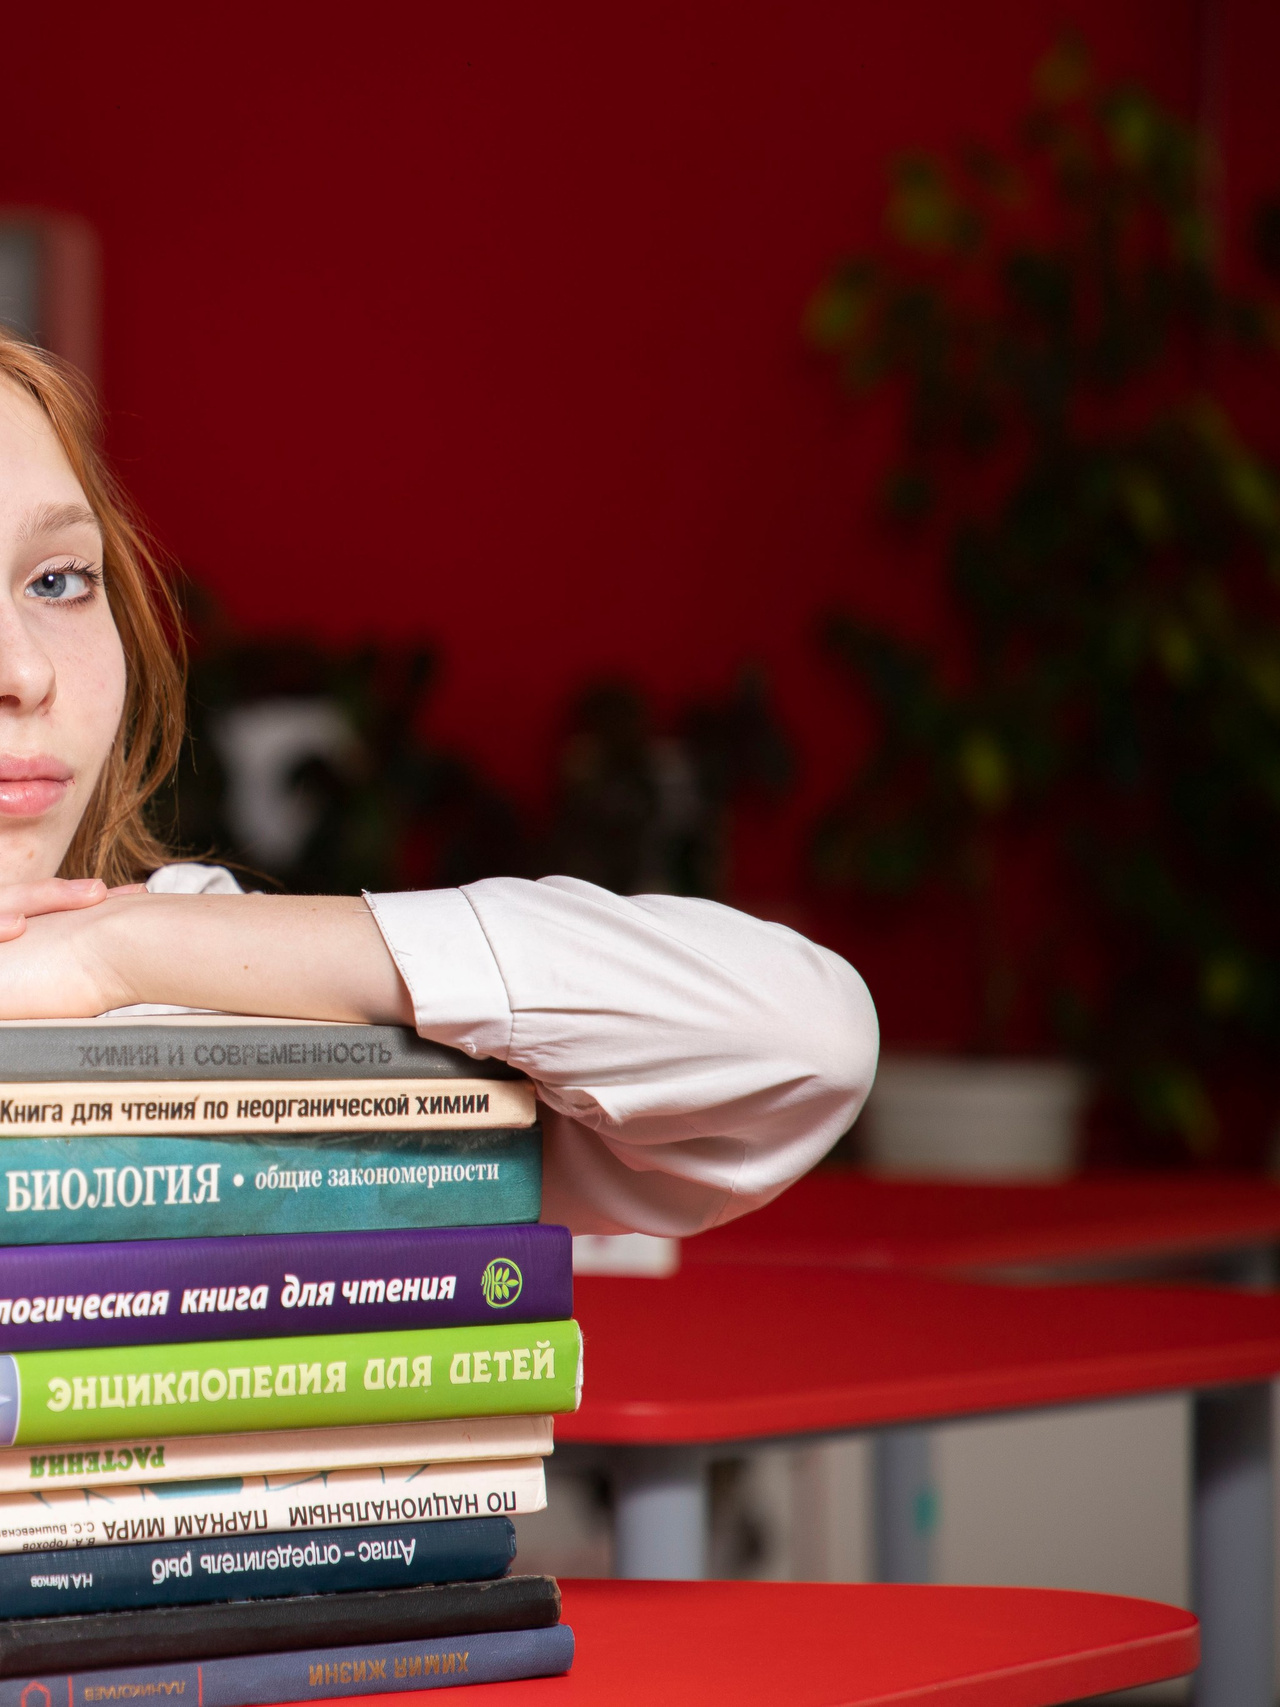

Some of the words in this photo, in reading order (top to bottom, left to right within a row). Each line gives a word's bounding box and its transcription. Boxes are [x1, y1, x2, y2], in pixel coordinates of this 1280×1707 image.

[78, 1044, 159, 1067] ХИМИЯ
[167, 1044, 185, 1066] И
[193, 1042, 393, 1066] СОВРЕМЕННОСТЬ
[0, 1099, 63, 1124] Книга
[71, 1101, 113, 1126] для
[121, 1100, 196, 1121] чтения
[203, 1100, 229, 1120] по
[237, 1093, 409, 1124] неорганической
[416, 1093, 490, 1116] химии
[5, 1163, 221, 1212] БИОЛОГИЯ
[255, 1164, 323, 1193] общие
[327, 1163, 500, 1189] закономерности
[180, 1284, 269, 1314] книга
[280, 1273, 336, 1309] для
[341, 1274, 457, 1304] чтения
[46, 1360, 348, 1413] ЭНЦИКЛОПЕДИЯ
[363, 1355, 433, 1391] ДЛЯ
[449, 1339, 556, 1385] ДЕТЕЙ
[29, 1445, 166, 1479] РАСТЕНИЯ
[288, 1492, 479, 1528] НАЦИОНАЛЬНЫМ
[487, 1490, 517, 1512] ПО
[102, 1516, 166, 1541] МИРА
[174, 1509, 268, 1535] ПАРКАМ
[30, 1574, 69, 1590] Мягков
[151, 1550, 193, 1585] рыб
[308, 1658, 388, 1687] ЖИЗНИ
[393, 1651, 470, 1680] ХИМИЯ
